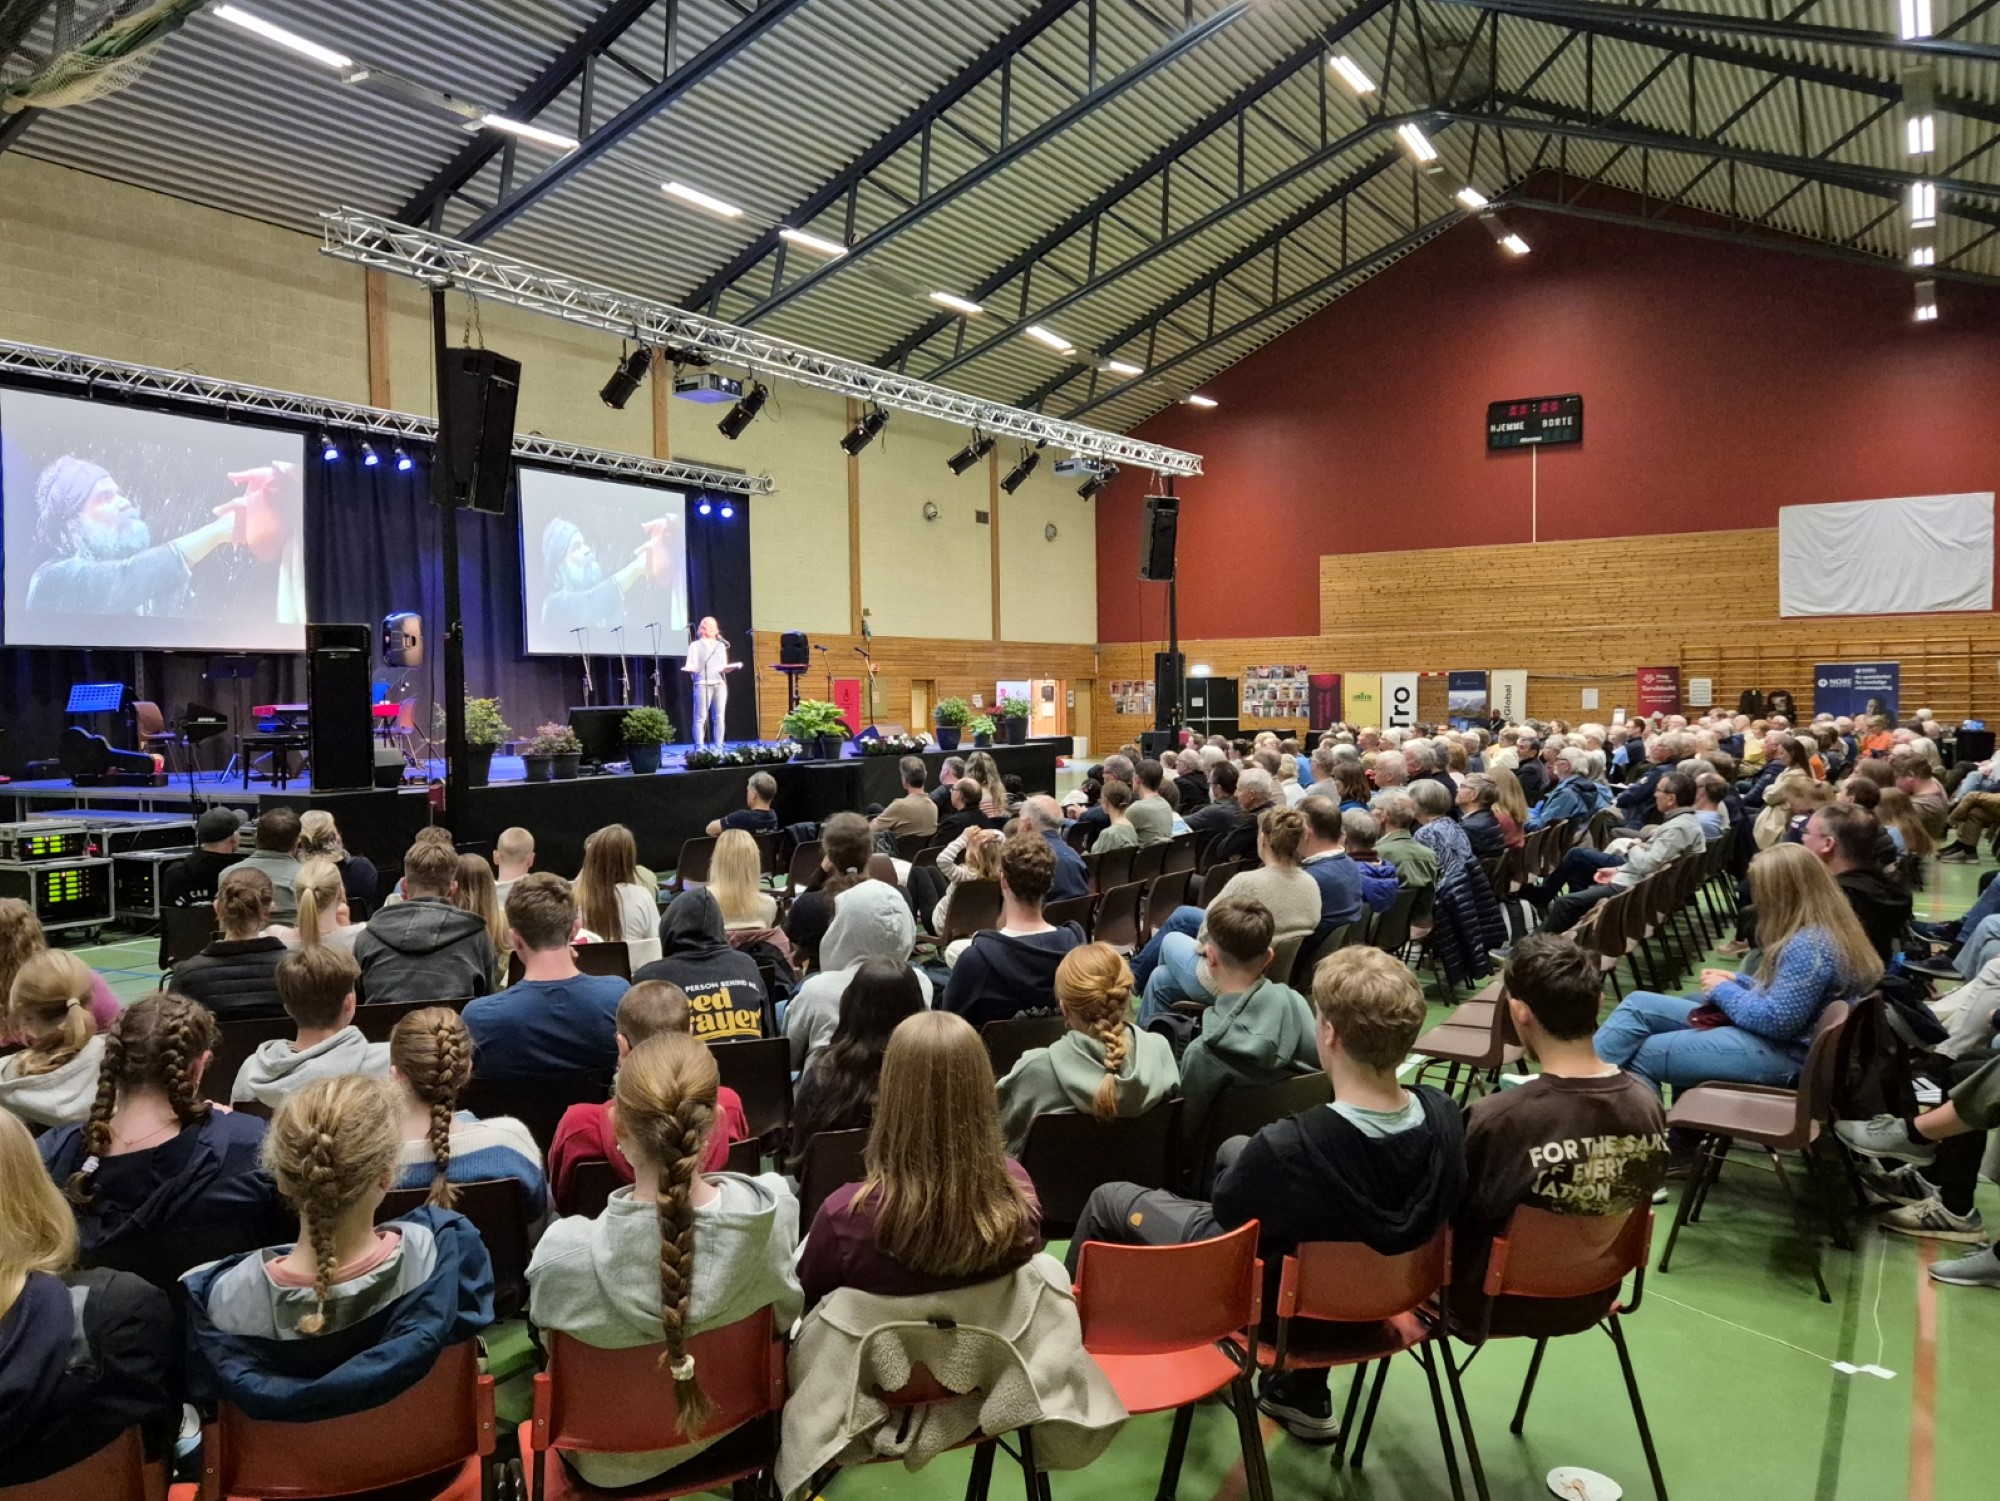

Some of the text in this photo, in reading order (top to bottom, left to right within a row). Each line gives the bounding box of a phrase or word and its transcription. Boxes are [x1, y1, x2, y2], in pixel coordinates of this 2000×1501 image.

[1490, 421, 1525, 432] HJEMME
[1542, 416, 1573, 428] BORTE
[1389, 687, 1410, 728] Tro
[685, 982, 719, 992] PERSON
[720, 979, 747, 987] BEHIND
[688, 987, 733, 1012] ed
[690, 1008, 761, 1033] ayer
[1529, 1139, 1579, 1168] FOR
[1581, 1135, 1618, 1156] THE
[1572, 1157, 1628, 1182] EVERY
